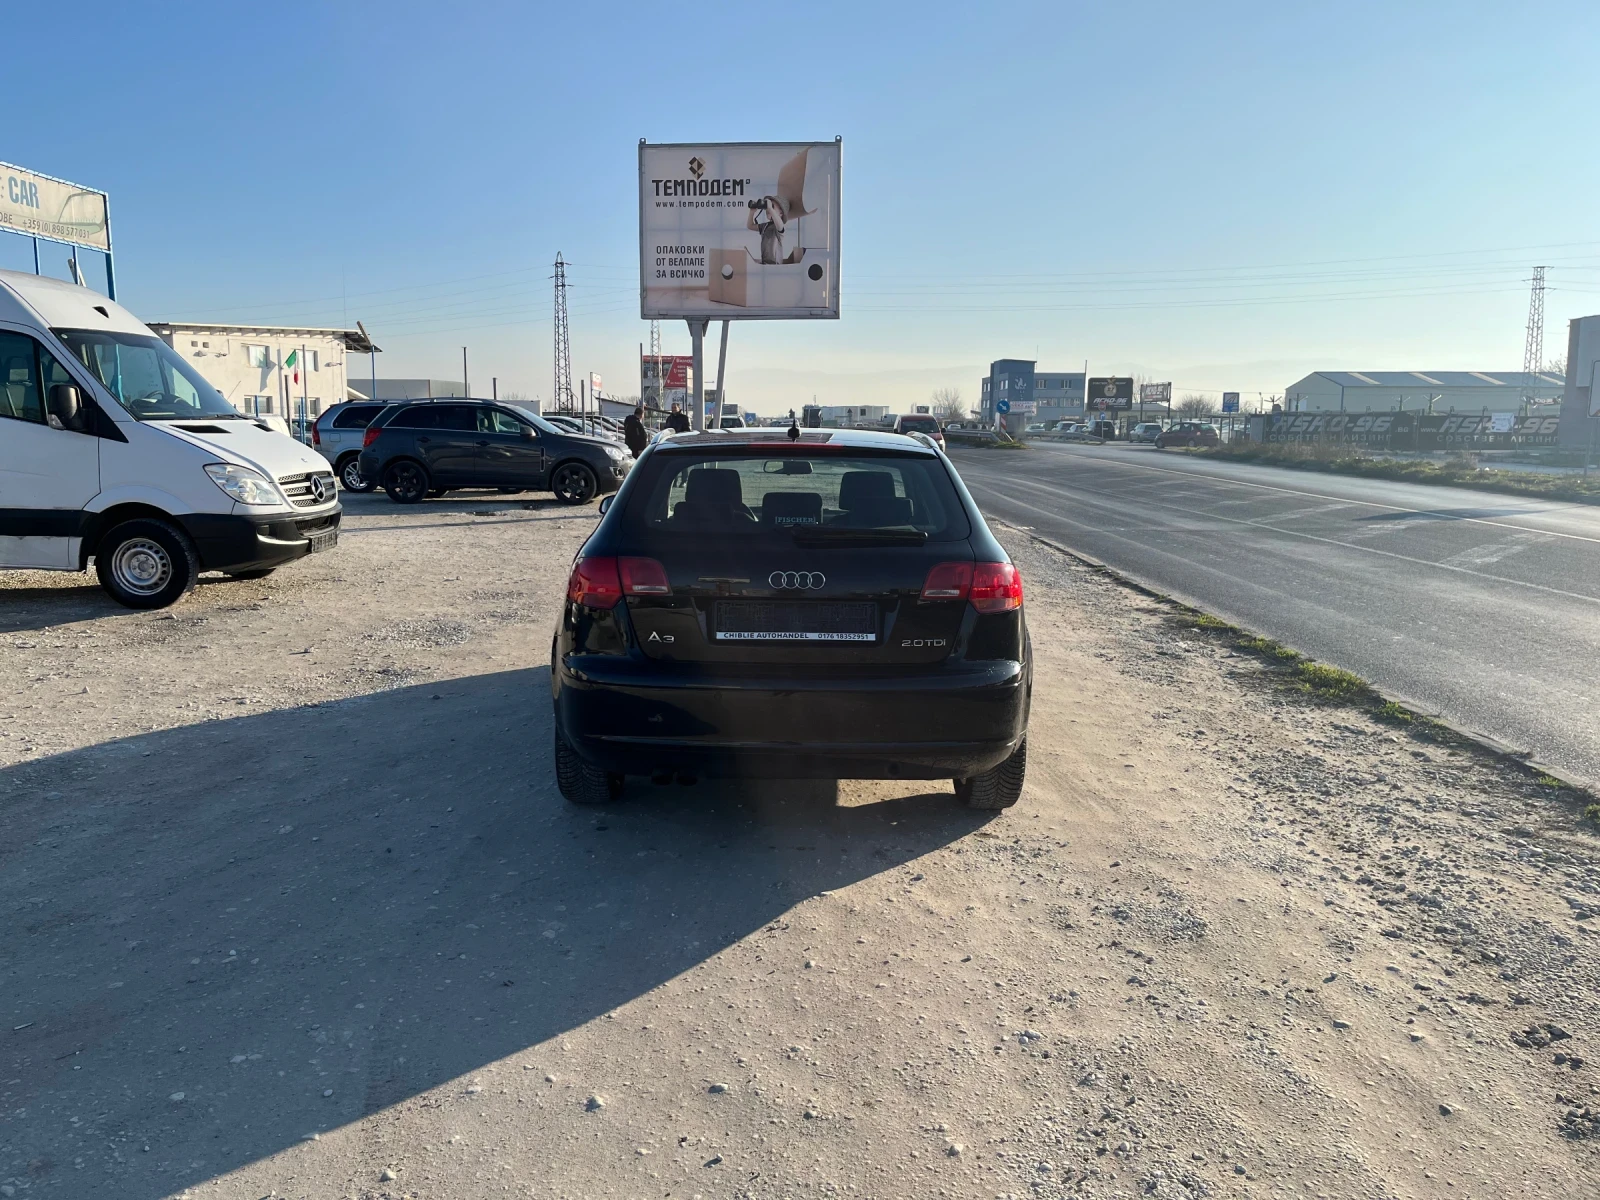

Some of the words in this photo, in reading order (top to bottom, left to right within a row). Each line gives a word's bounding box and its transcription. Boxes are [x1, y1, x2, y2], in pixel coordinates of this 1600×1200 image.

[8, 176, 40, 209] CAR
[652, 179, 744, 196] ТЕМПОДЕМ
[656, 200, 744, 208] www.tempodem.com
[22, 218, 40, 231] +359
[41, 221, 51, 234] (0)
[52, 223, 65, 236] 898
[65, 225, 78, 238] 577
[78, 228, 90, 239] 031
[656, 245, 705, 255] ОПАКОВКИ
[656, 257, 666, 267] ОТ
[668, 257, 705, 266] ВЕЛПАПЕ
[656, 269, 667, 279] ЗА
[670, 269, 705, 279] ВСИЧКО
[647, 631, 675, 644] A3
